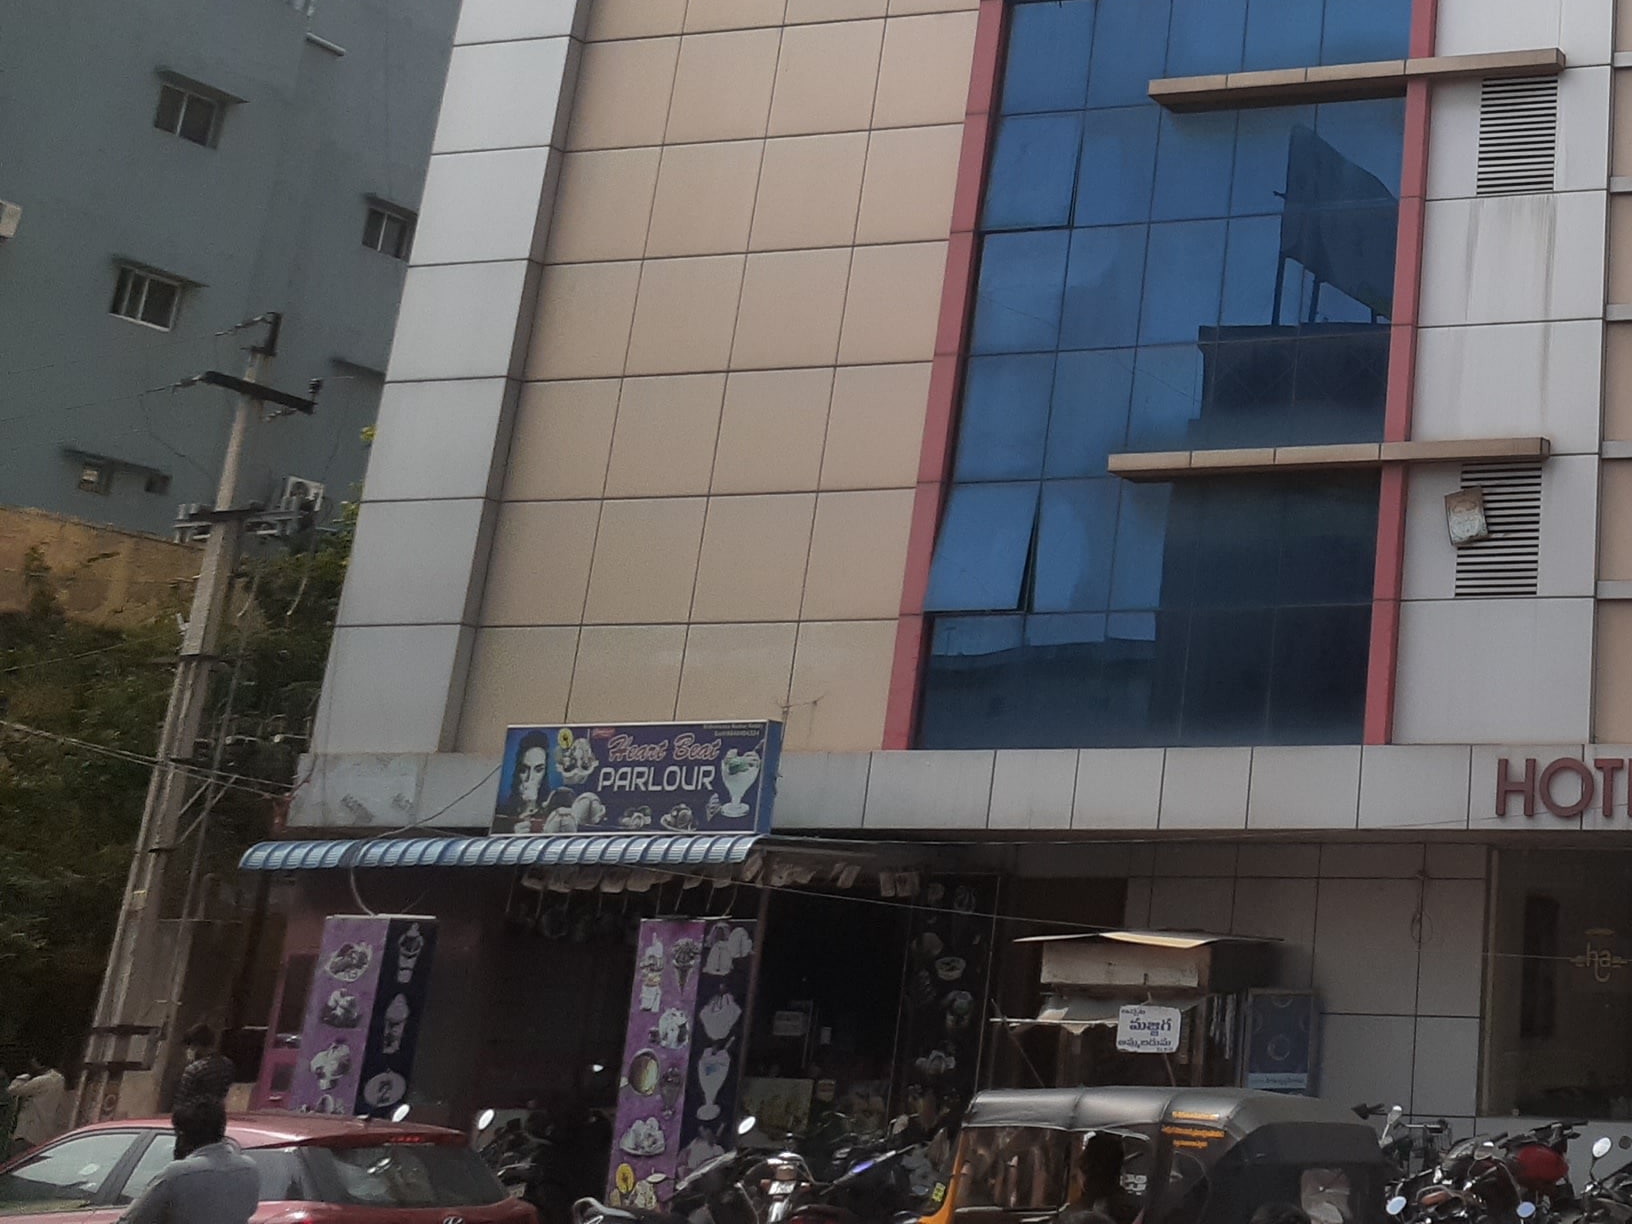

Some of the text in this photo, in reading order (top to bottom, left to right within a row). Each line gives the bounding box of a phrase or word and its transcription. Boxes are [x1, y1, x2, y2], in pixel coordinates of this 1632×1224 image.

[608, 732, 722, 763] Heart Beat
[597, 765, 715, 792] PARLOUR
